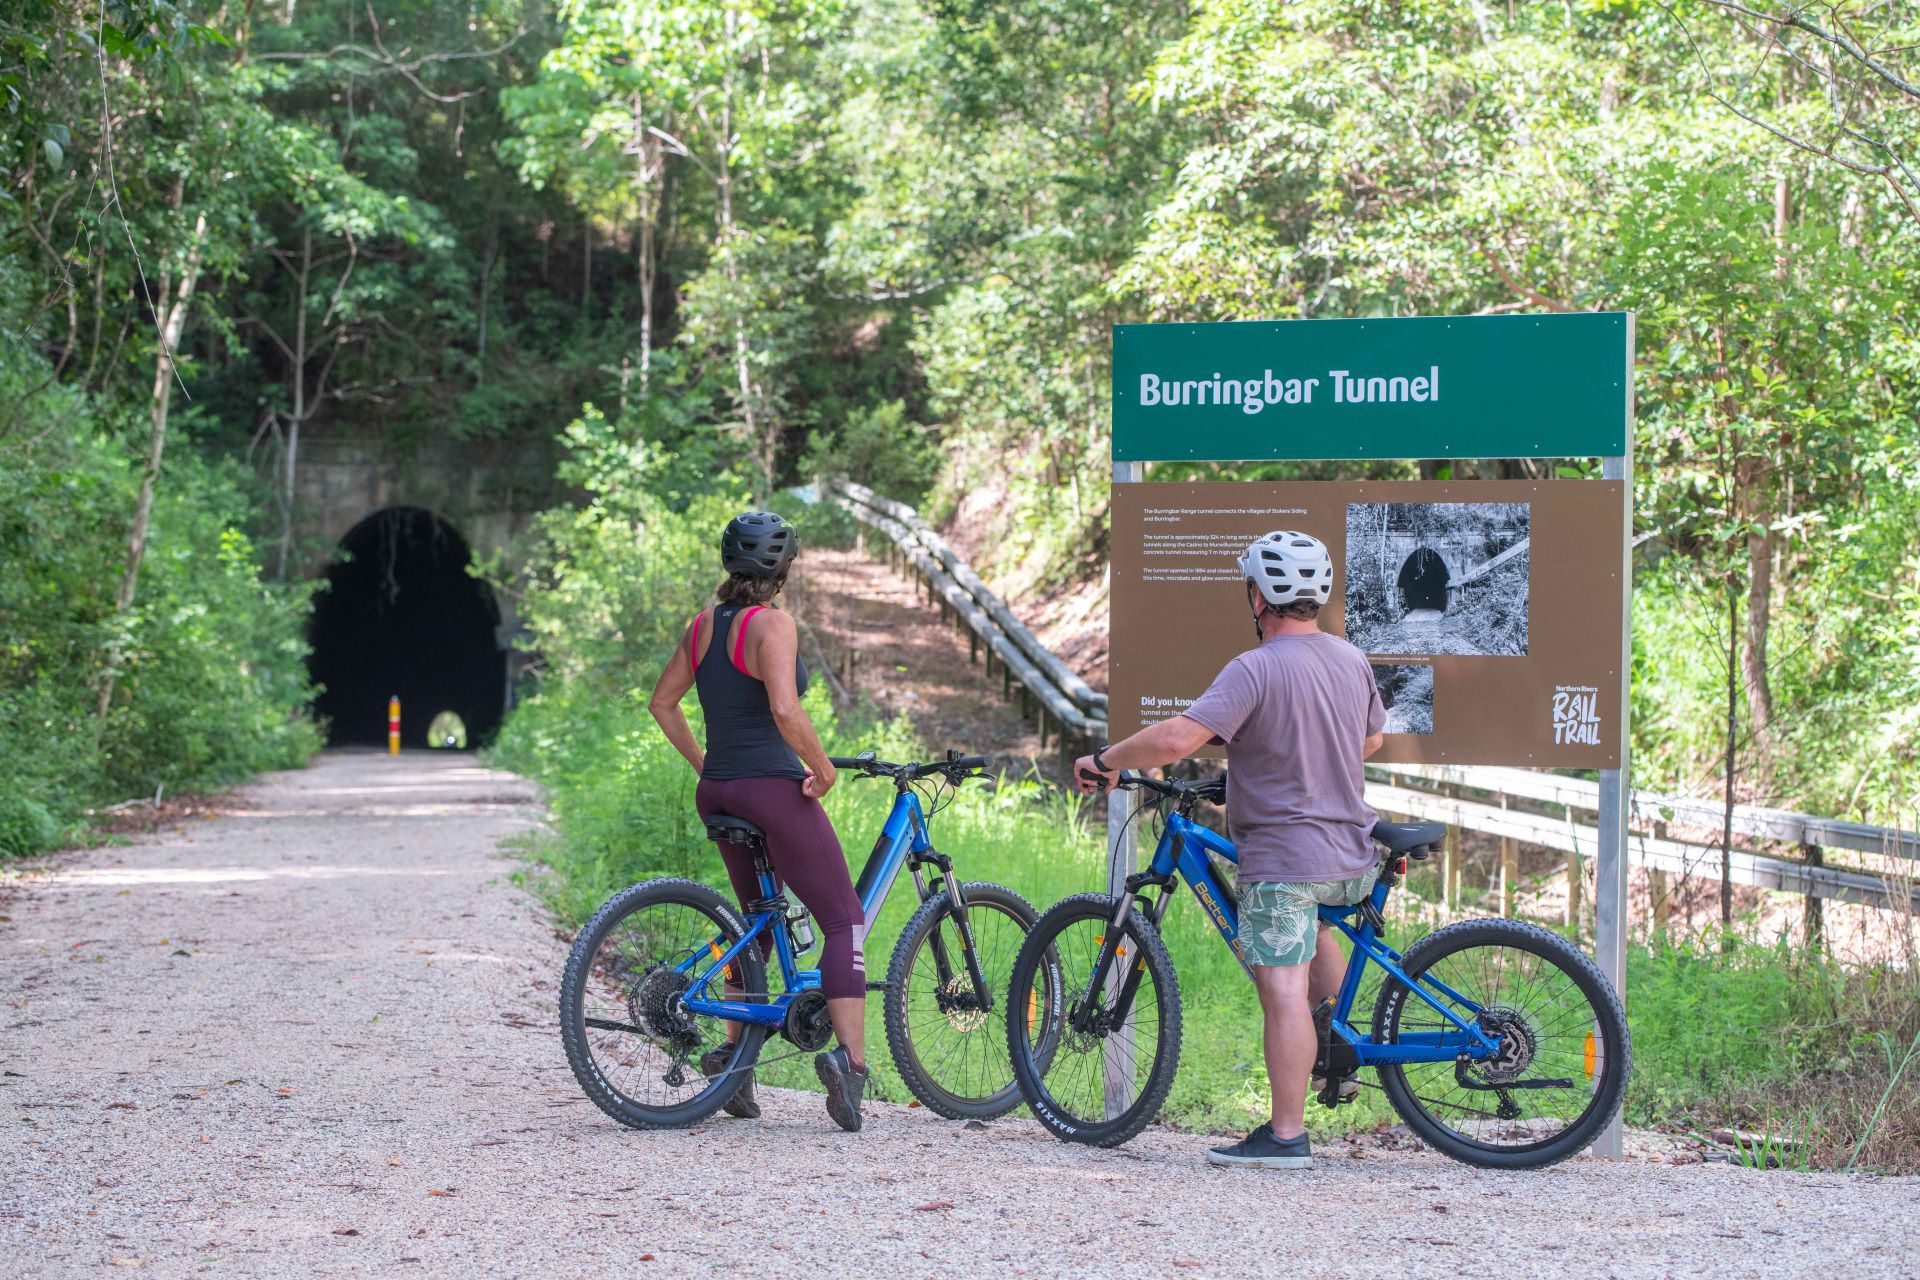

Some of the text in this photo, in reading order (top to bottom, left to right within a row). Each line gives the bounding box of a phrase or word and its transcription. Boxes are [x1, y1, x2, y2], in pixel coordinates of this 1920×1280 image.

[1140, 366, 1438, 414] Burringbar Tunnel
[1141, 696, 1156, 706] Did
[1157, 699, 1173, 708] you
[1552, 692, 1601, 723] RAIL
[1553, 719, 1602, 745] TRAIL
[1194, 881, 1234, 935] Better
[586, 1055, 624, 1105] MAXXIS
[1035, 1101, 1078, 1135] MAXXIS
